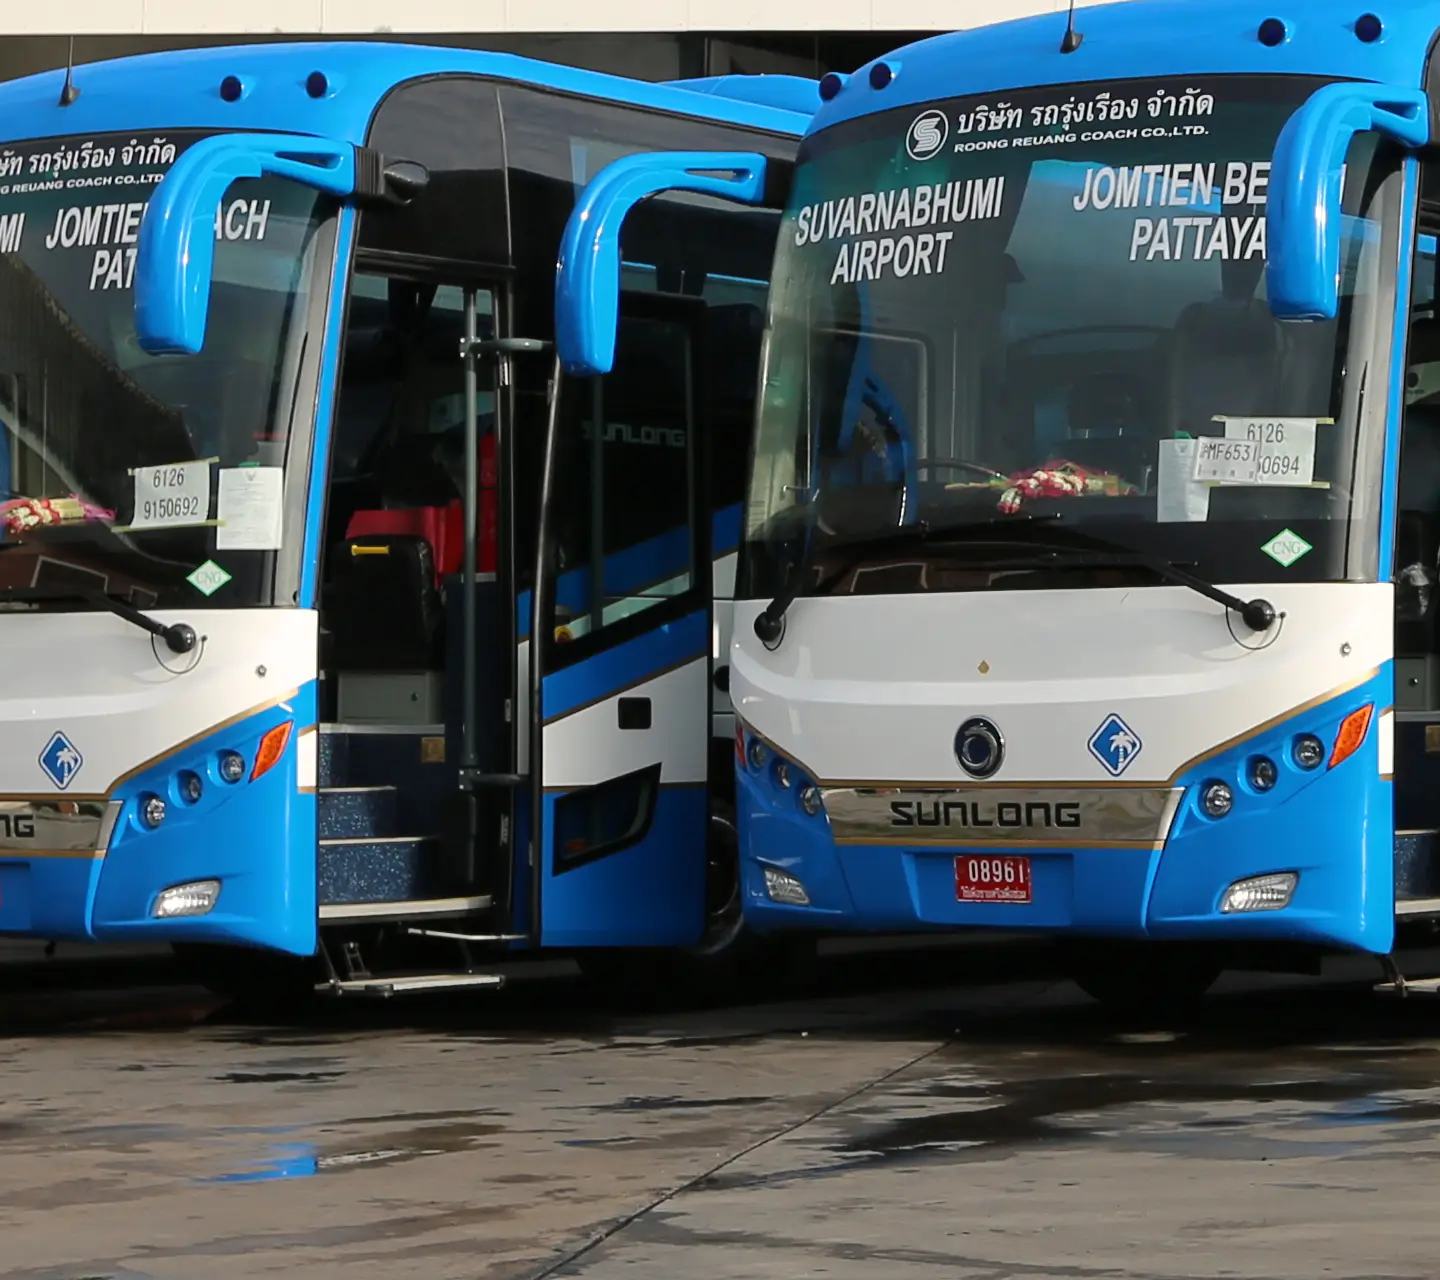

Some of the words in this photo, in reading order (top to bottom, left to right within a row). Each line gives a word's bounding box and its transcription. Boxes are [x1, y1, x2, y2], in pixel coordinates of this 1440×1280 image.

[957, 102, 1023, 134] บริษัท
[1030, 91, 1139, 131] รถรุ่งเรือง
[1147, 87, 1215, 118] จำกัด
[954, 138, 1008, 153] ROONG
[1012, 132, 1077, 148] REUANG
[1080, 128, 1138, 143] COACH
[1140, 124, 1209, 138] CO.,LTD.
[28, 141, 116, 180] รถรุ่งเรือง
[121, 138, 177, 166] จำกัด
[11, 180, 64, 195] REUANG
[66, 175, 113, 190] COACH
[1072, 162, 1216, 212] JOMTIEN
[795, 176, 1005, 247] SUVARNABHUMI
[45, 201, 148, 250] JOMTIE
[1129, 216, 1266, 261] PATTAYA
[830, 231, 953, 285] AIRPORT
[1247, 423, 1284, 444] 6126
[152, 468, 185, 489] 6126
[1258, 455, 1300, 476] 0694
[144, 496, 199, 520] 9150692
[1271, 541, 1301, 556] CNG
[195, 570, 222, 585] CNG
[890, 801, 1082, 828] SUNLONG
[968, 859, 1024, 884] 08961
